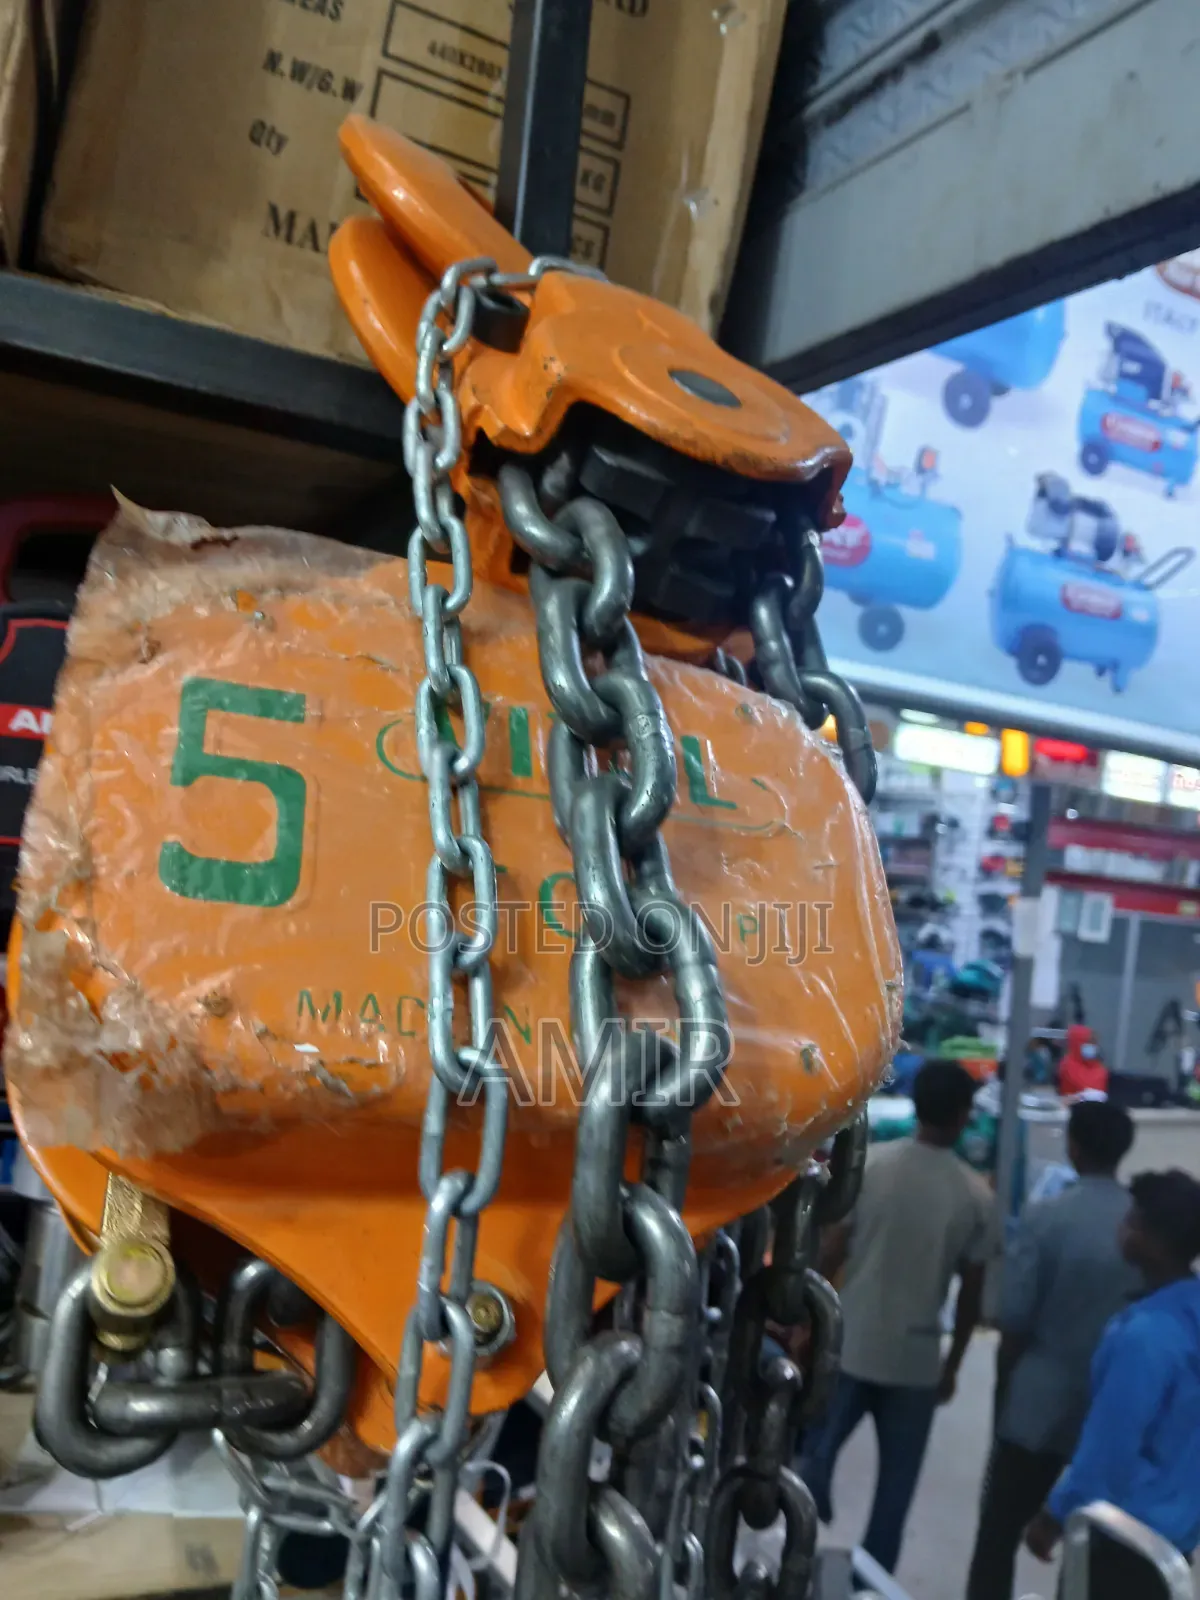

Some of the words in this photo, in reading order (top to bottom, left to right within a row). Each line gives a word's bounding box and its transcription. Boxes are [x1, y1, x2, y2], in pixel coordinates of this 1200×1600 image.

[248, 118, 289, 156] Qty
[260, 200, 338, 254] MA
[158, 676, 307, 907] 5
